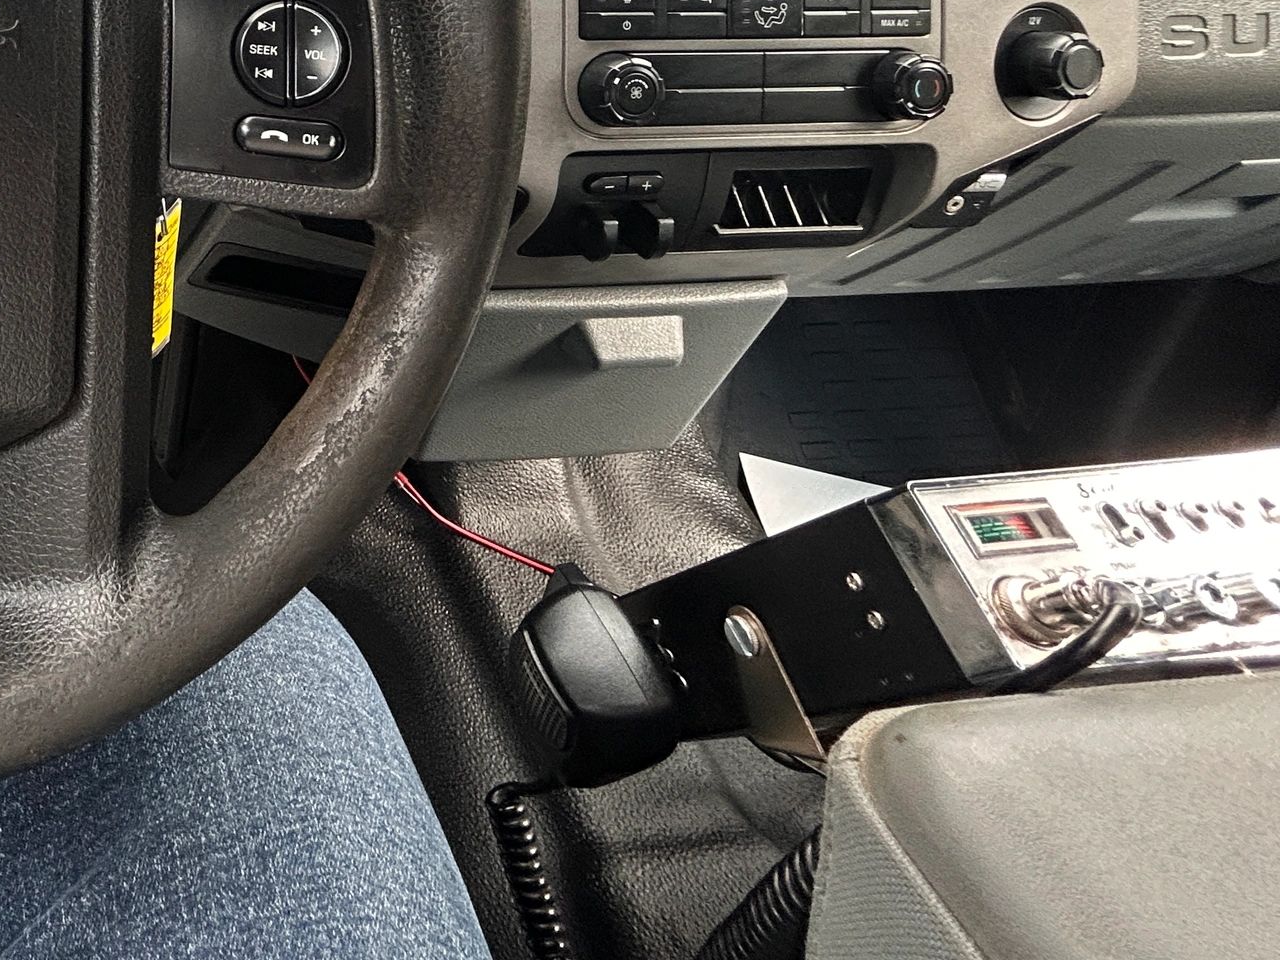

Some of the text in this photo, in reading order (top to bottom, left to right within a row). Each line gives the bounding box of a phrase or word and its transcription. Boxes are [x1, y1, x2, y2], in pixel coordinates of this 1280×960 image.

[880, 19, 910, 27] MAX A/C
[1028, 16, 1042, 26] 12V
[1161, 12, 1271, 60] SU
[249, 44, 278, 56] SEEK
[304, 50, 326, 61] VOL
[302, 134, 320, 146] OK
